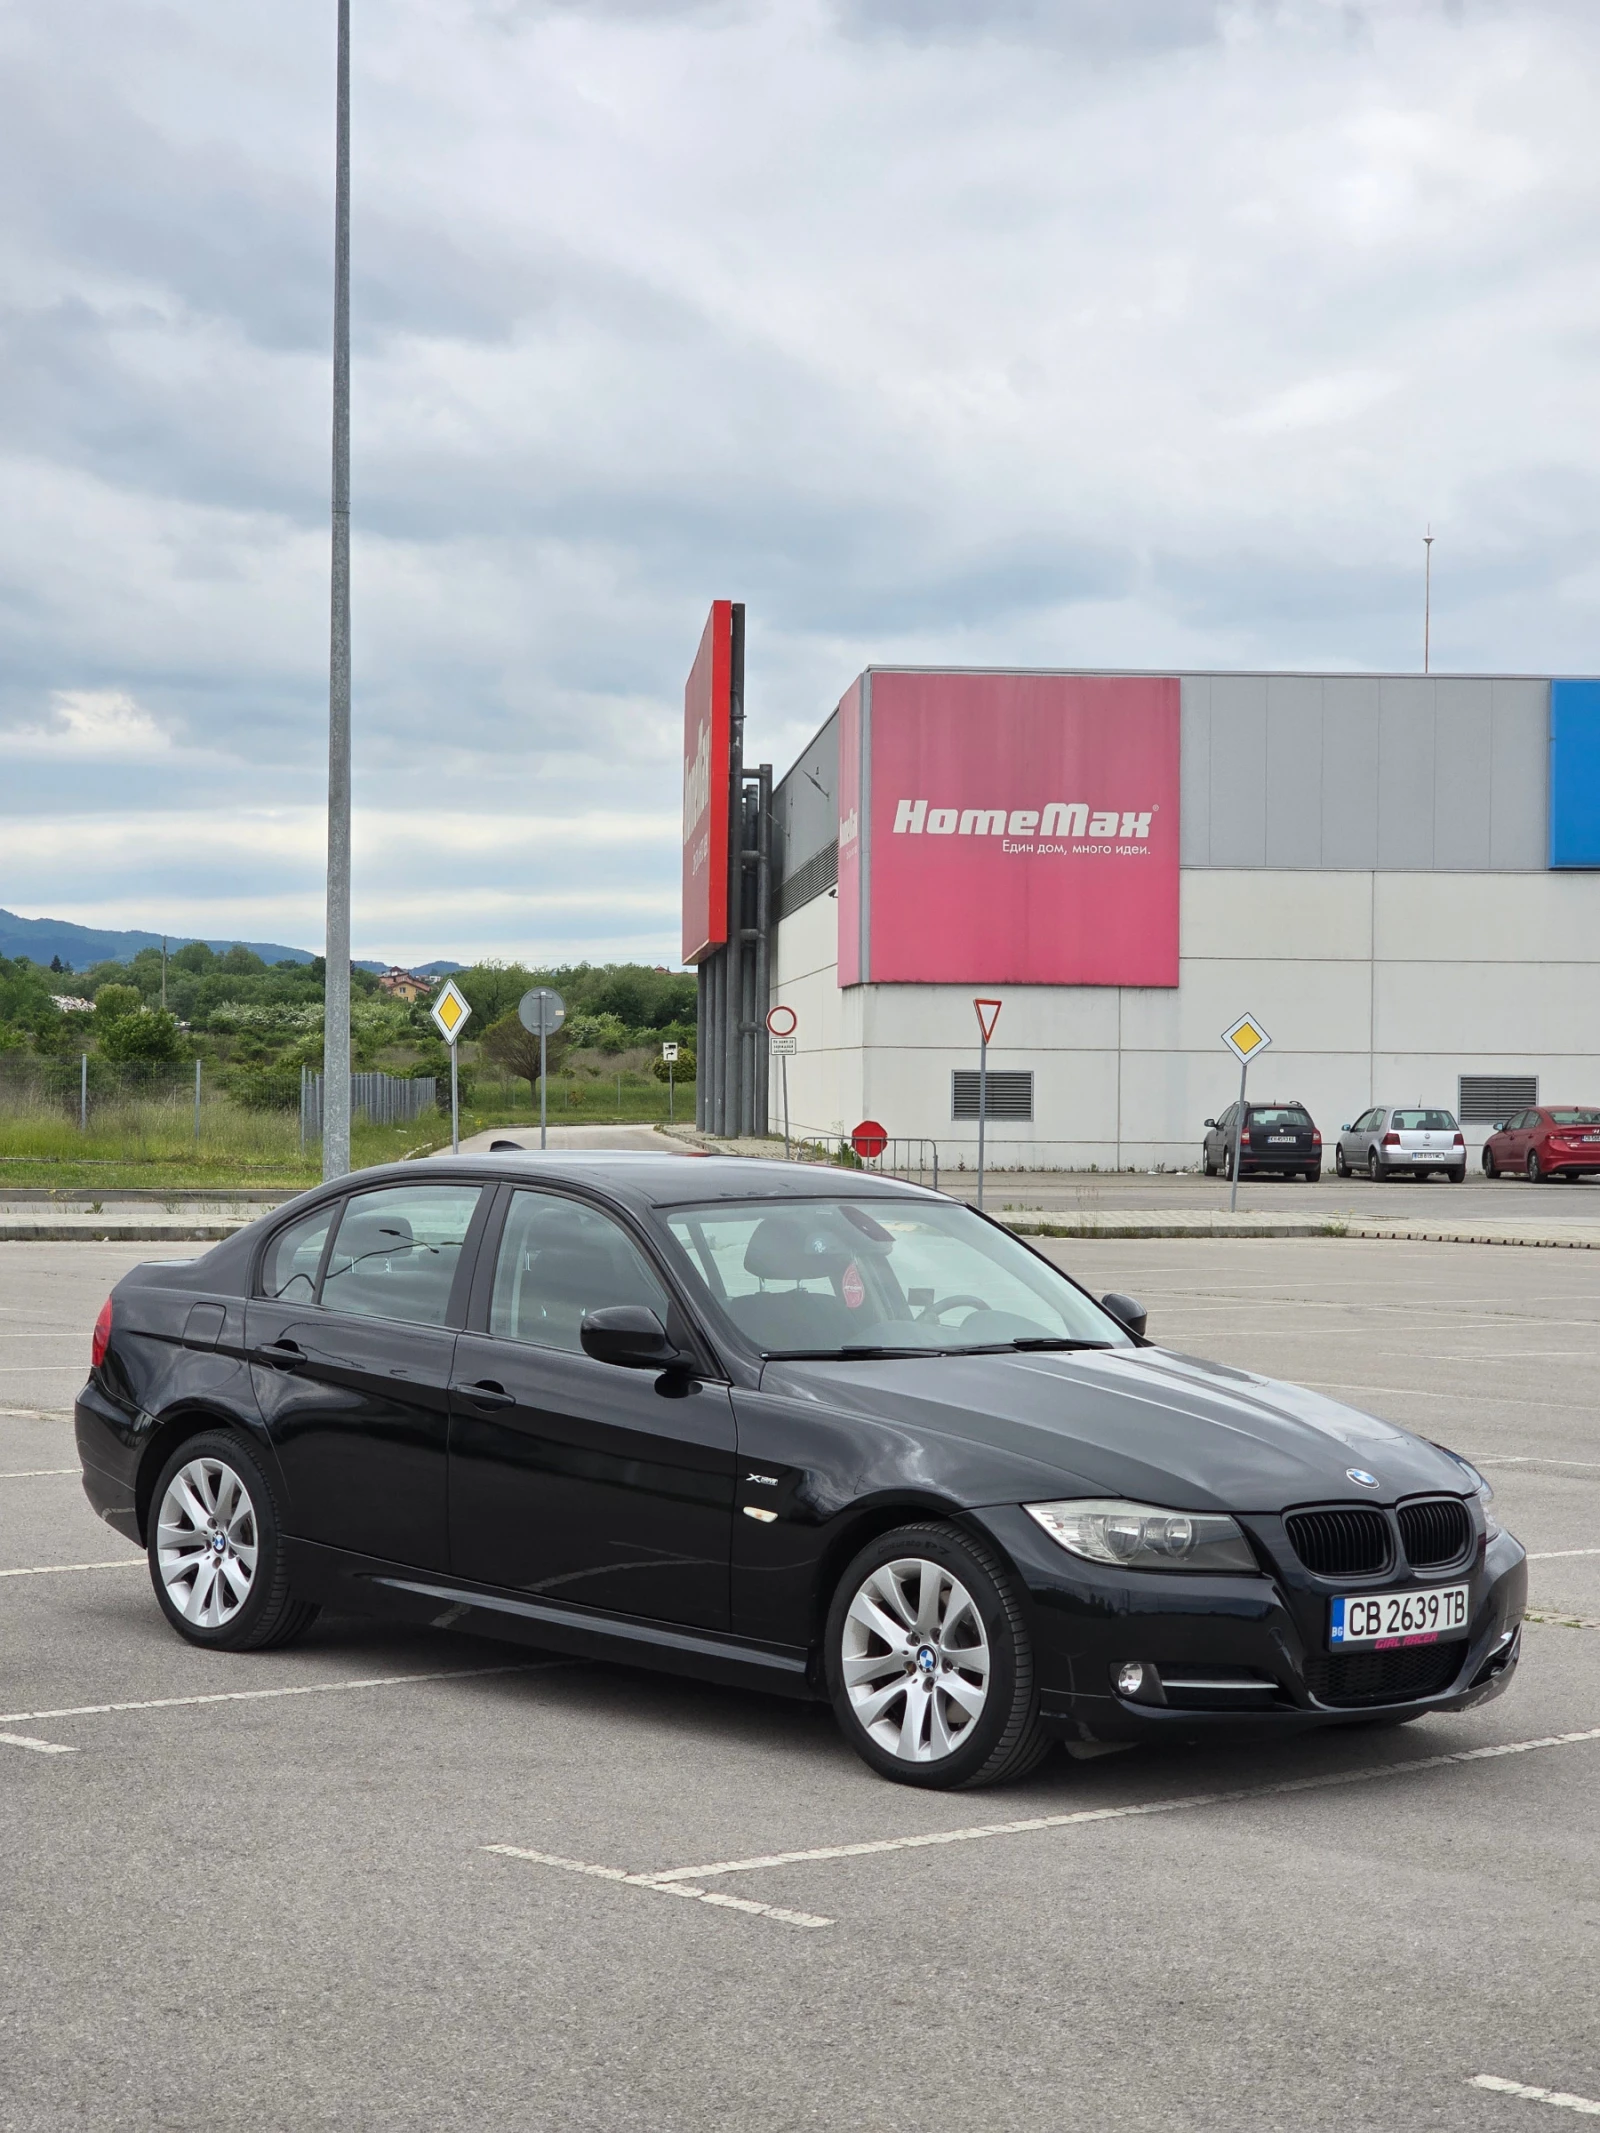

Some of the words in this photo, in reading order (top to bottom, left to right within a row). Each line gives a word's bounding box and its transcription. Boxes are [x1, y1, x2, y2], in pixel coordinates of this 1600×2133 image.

[893, 800, 1152, 838] HomeMax
[1002, 839, 1034, 854] Един
[1037, 843, 1068, 856] дом,
[1072, 844, 1112, 856] много
[1115, 844, 1151, 856] идеи.
[1349, 1600, 1382, 1636] CB
[1386, 1594, 1440, 1634] 2639
[1443, 1590, 1466, 1626] TB
[1332, 1626, 1344, 1638] BG
[1375, 1637, 1401, 1650] GIRL
[1403, 1631, 1439, 1647] RACER
